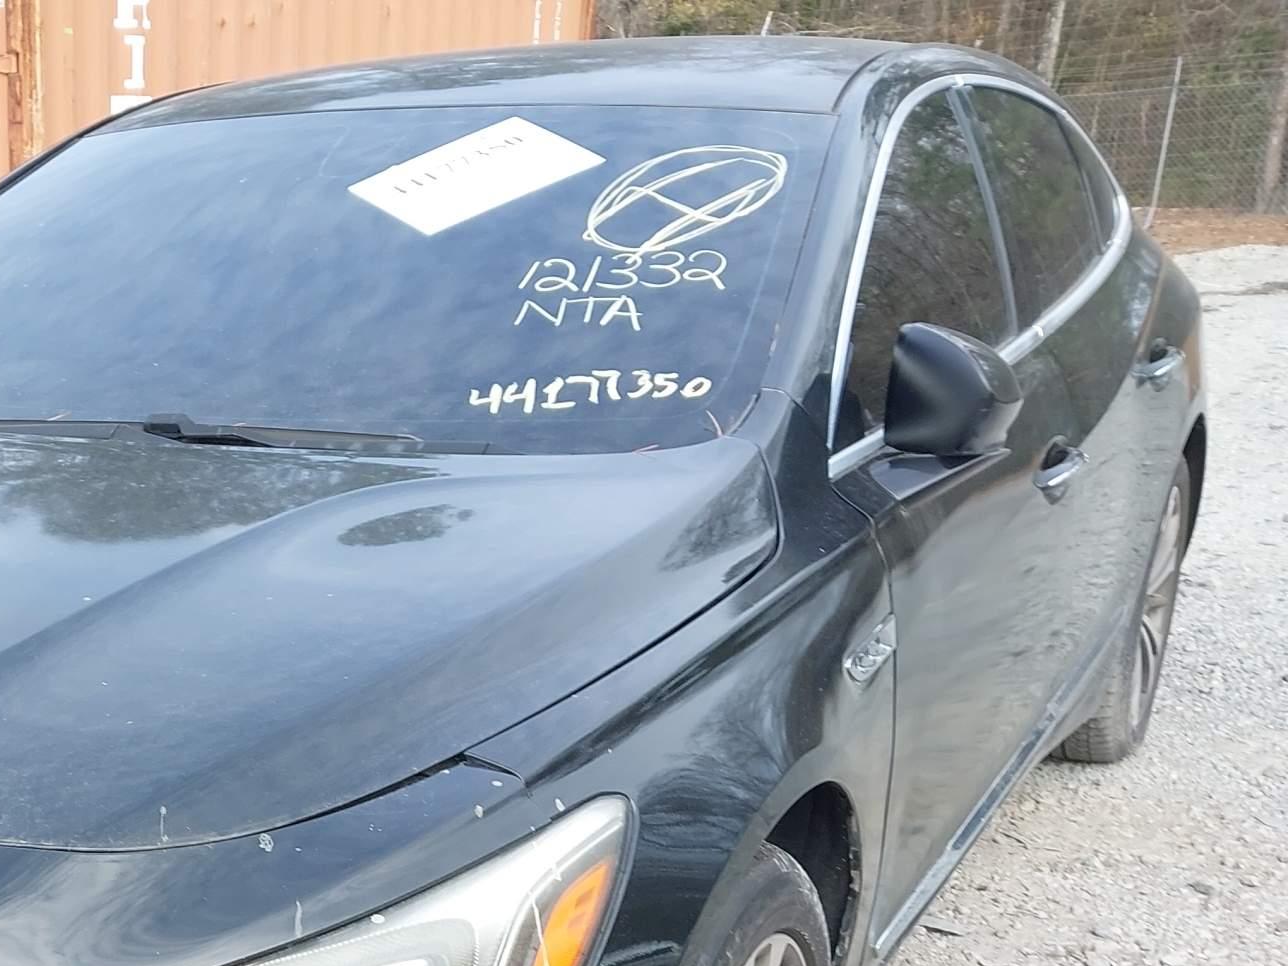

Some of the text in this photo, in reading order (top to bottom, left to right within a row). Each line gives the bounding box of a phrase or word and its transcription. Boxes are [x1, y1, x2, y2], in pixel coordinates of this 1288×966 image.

[518, 250, 728, 293] 121332
[514, 295, 643, 331] NTA
[469, 370, 712, 414] 44177350
